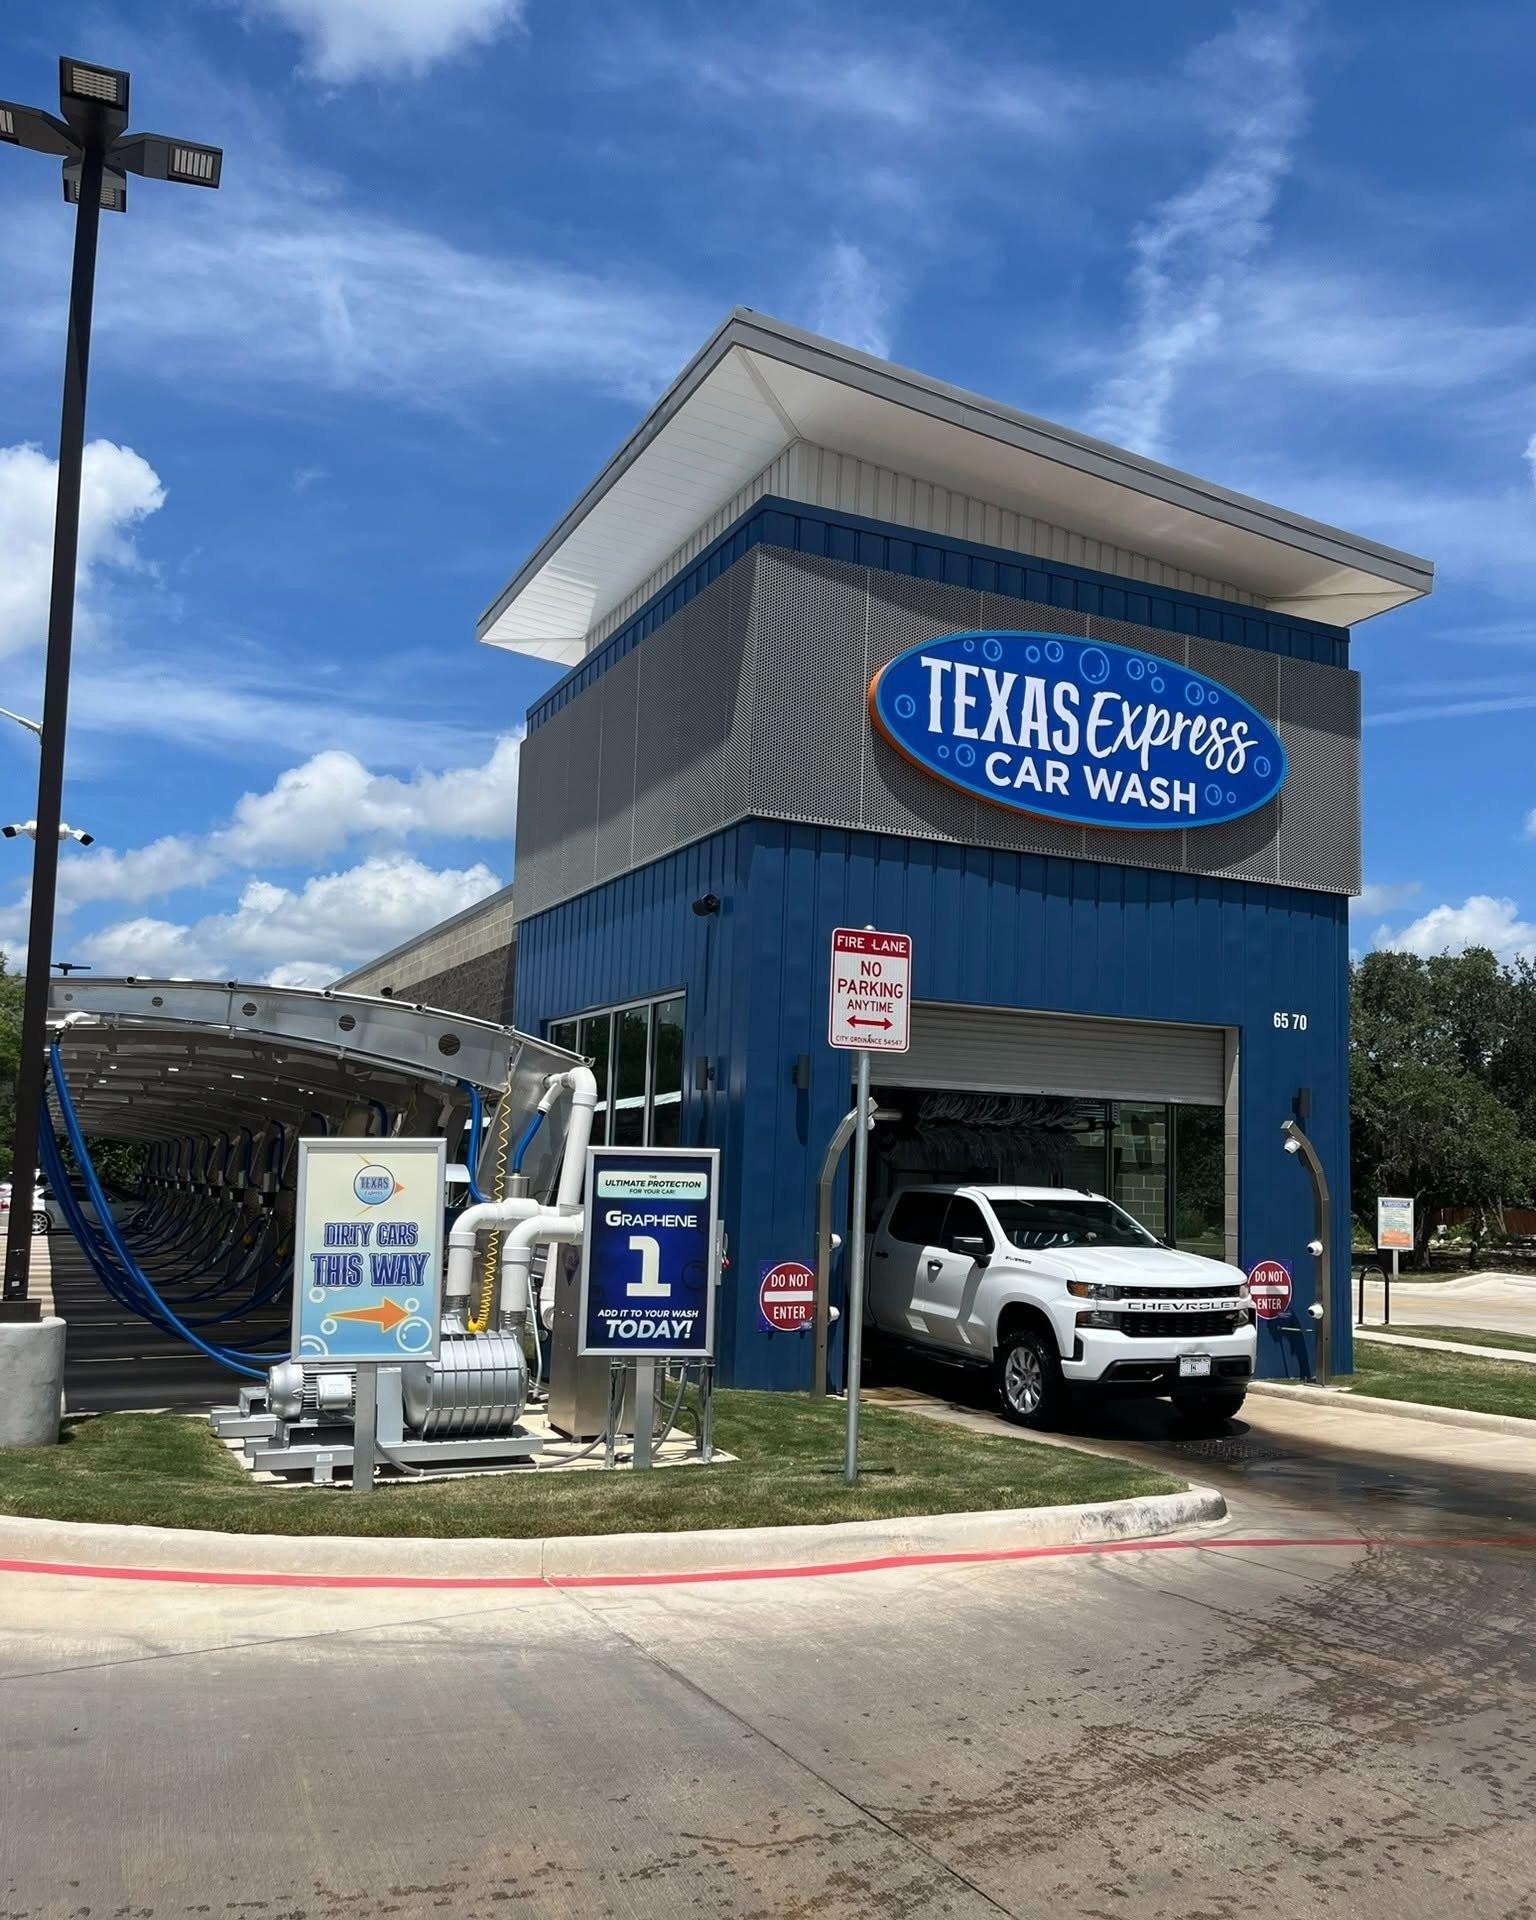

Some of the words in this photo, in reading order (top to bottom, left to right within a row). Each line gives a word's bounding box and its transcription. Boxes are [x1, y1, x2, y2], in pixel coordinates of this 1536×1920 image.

[920, 655, 1080, 756] TEXAS
[1086, 692, 1259, 774] Express
[985, 751, 1070, 796] CAR
[1083, 765, 1197, 815] WASH
[837, 935, 865, 949] FIRE
[872, 939, 907, 953] LANE
[860, 960, 882, 977] NO
[837, 978, 904, 999] PARKING
[847, 999, 894, 1013] ANYTIME
[359, 1176, 390, 1190] TEXAS
[605, 1179, 646, 1188] ULTIMATE
[647, 1180, 702, 1189] PROTECTION
[323, 1222, 374, 1247] DIRTY
[376, 1222, 419, 1247] CARS
[310, 1252, 363, 1287] THIS
[369, 1252, 431, 1287] WAY
[626, 1235, 672, 1297] 1
[771, 1274, 786, 1288] DO
[789, 1273, 809, 1287] NOT
[1255, 1271, 1267, 1283] DO
[1268, 1271, 1284, 1283] NOT
[1128, 1301, 1240, 1311] CHEVROLET
[1257, 1299, 1282, 1310] ENTER
[598, 1309, 619, 1317] ADD
[630, 1310, 643, 1318] TO
[645, 1310, 670, 1318] YOUR
[672, 1310, 699, 1318] WASH
[773, 1306, 806, 1320] ENTER
[606, 1319, 693, 1339] TODAY!
